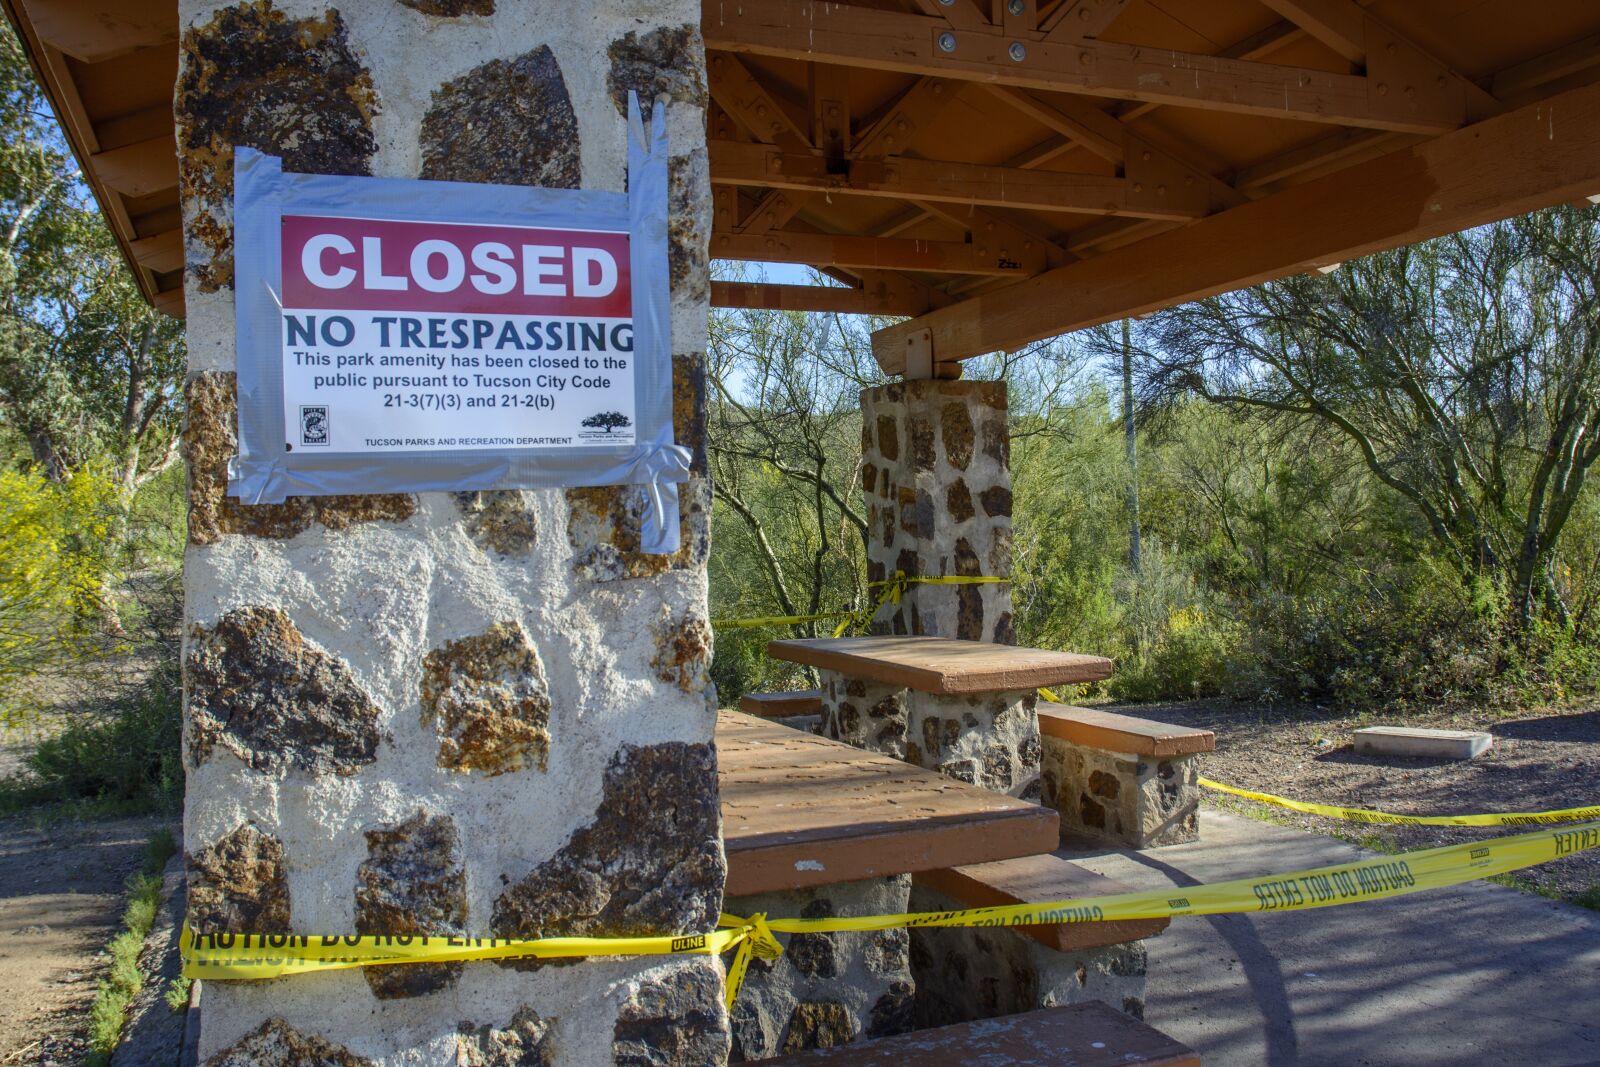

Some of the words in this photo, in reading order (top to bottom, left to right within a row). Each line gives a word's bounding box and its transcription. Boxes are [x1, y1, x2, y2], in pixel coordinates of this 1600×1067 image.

[301, 233, 618, 299] CLOSED
[283, 315, 356, 347] NO
[371, 316, 634, 352] TRESPASSING
[293, 351, 331, 366] This
[337, 352, 374, 369] park
[380, 353, 446, 370] amenity
[451, 354, 480, 368] has
[485, 355, 523, 368] been
[528, 355, 579, 369] closed
[584, 357, 599, 369] to
[604, 357, 627, 369] the
[314, 373, 367, 390] public
[373, 375, 448, 390] pursuant
[453, 375, 469, 388] to
[473, 374, 531, 388] Tucson
[536, 375, 567, 391] City
[571, 376, 611, 388] Code
[383, 393, 461, 411] 21-3(7)(3)
[466, 395, 496, 408] and
[501, 394, 555, 410] 21-2(b)
[365, 438, 403, 446] TUCSON
[405, 438, 435, 446] PARKS
[437, 438, 456, 446] AND
[458, 437, 514, 446] RECREATION
[516, 437, 573, 445] DEPARTMENT
[672, 936, 705, 952] ULINE
